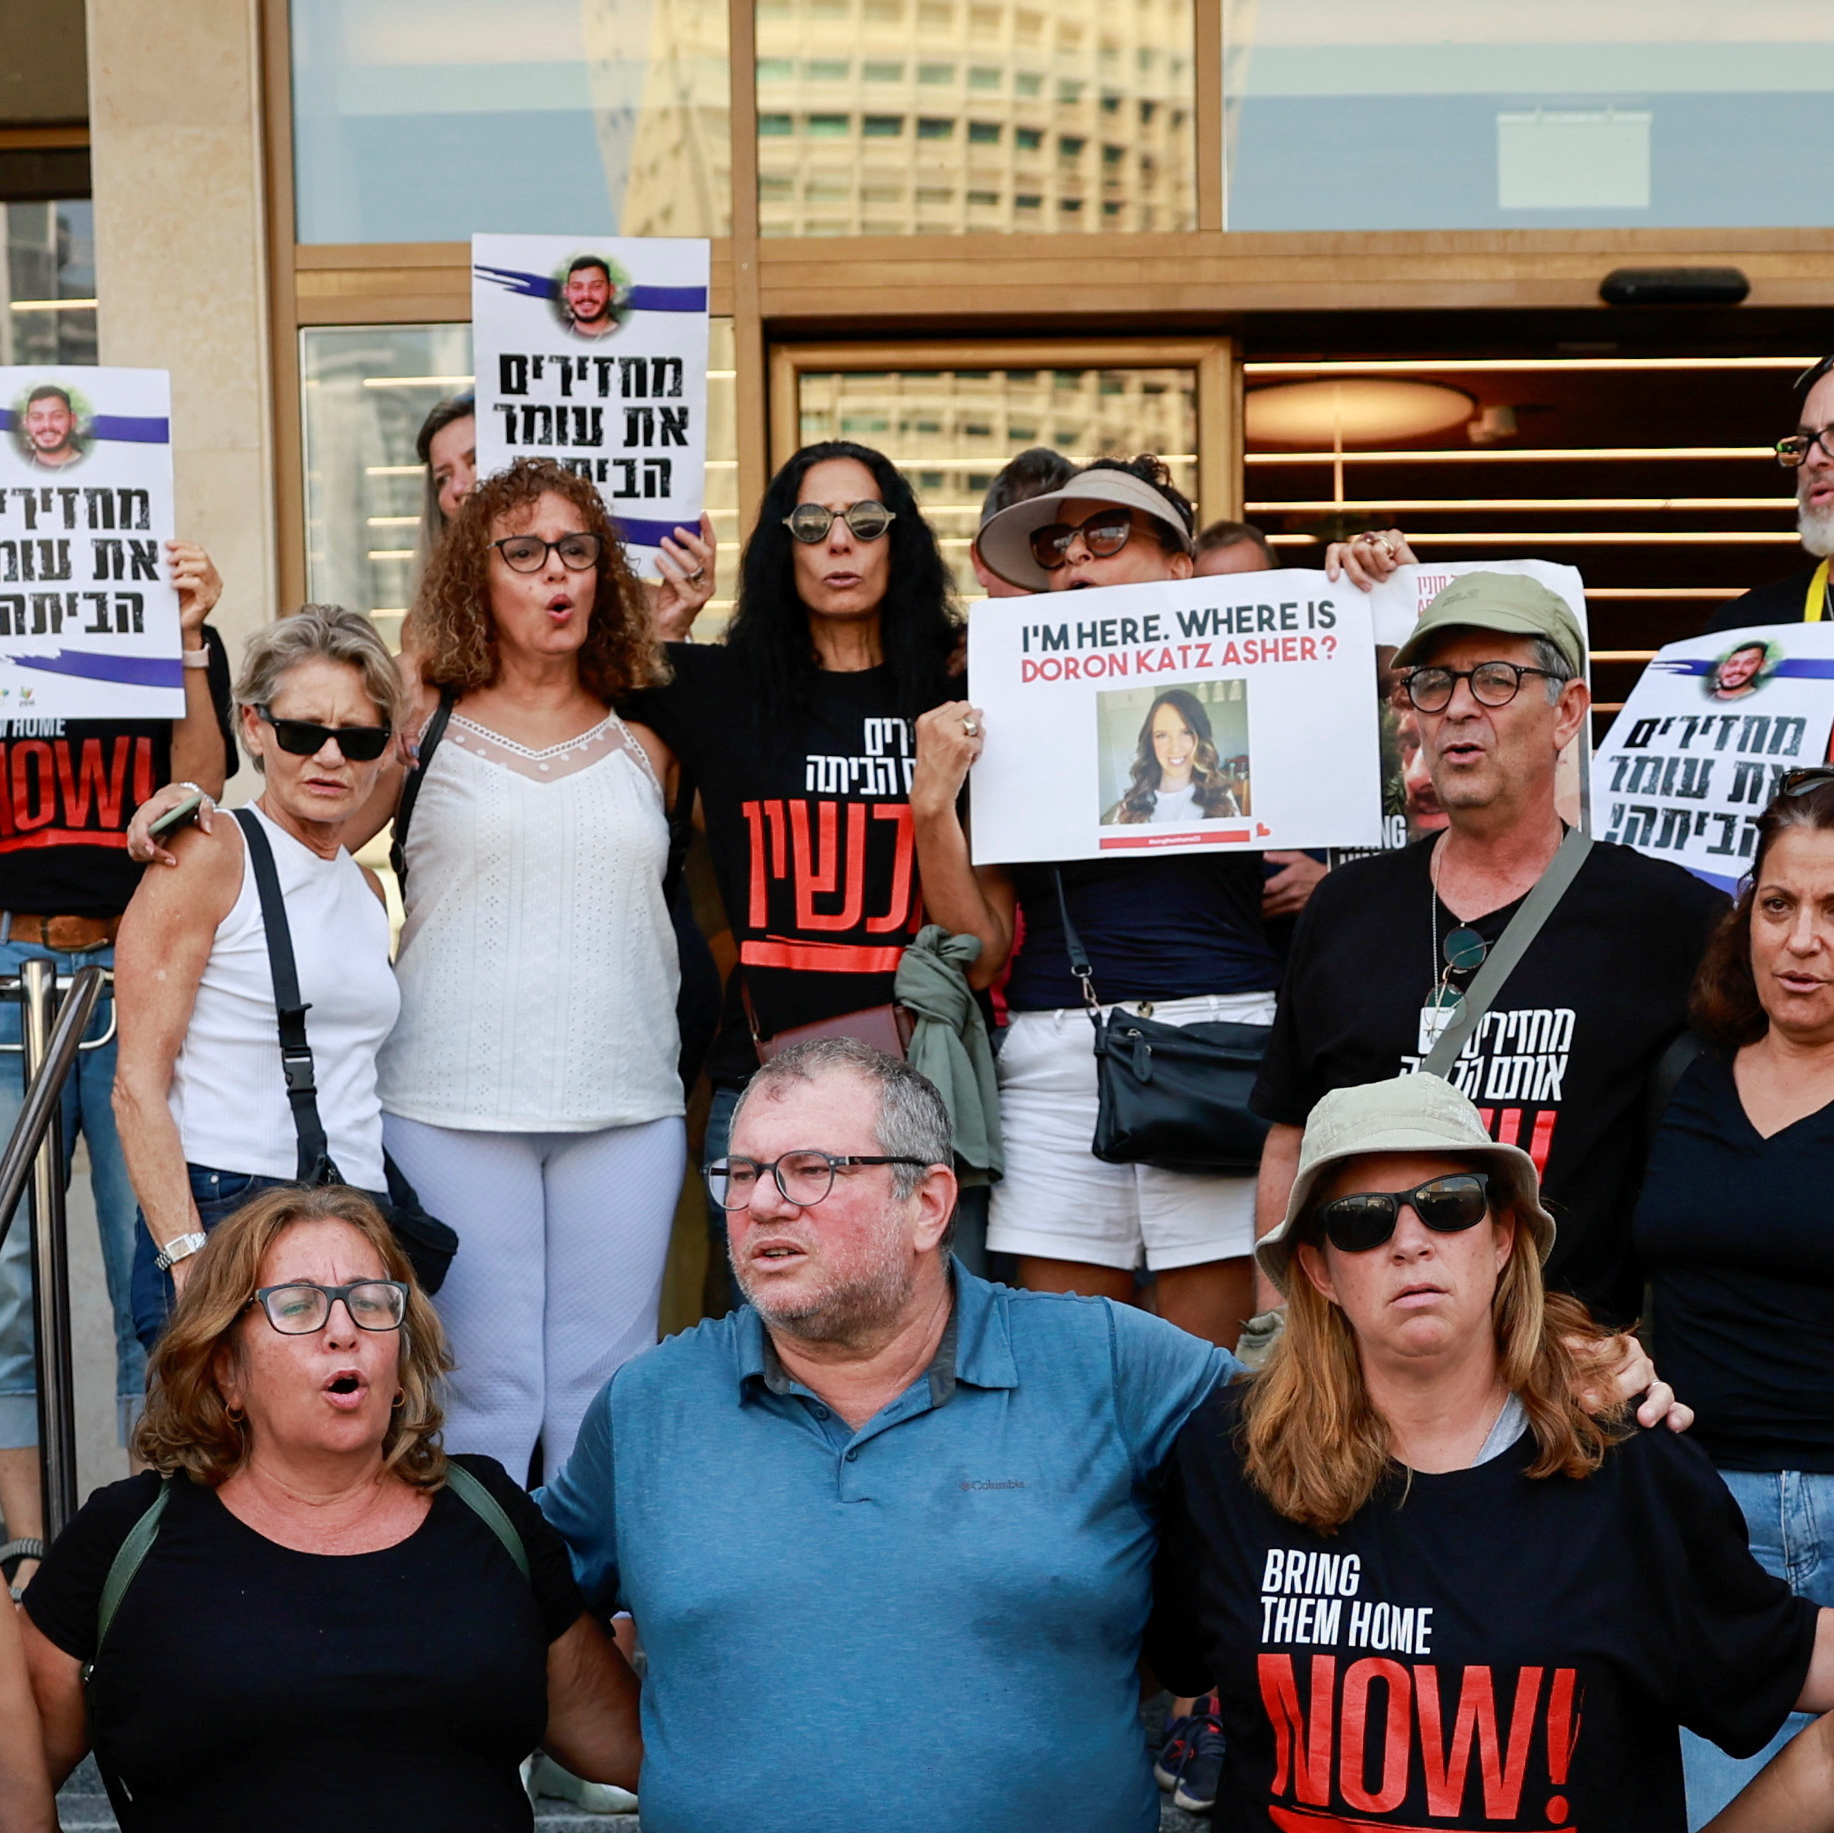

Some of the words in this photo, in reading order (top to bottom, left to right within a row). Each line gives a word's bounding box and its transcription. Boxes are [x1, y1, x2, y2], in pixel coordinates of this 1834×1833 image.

[499, 353, 683, 398] מחזירים
[493, 403, 603, 447] עומר
[623, 406, 689, 447] את
[91, 538, 160, 581] את
[1022, 623, 1068, 653] I'M
[1076, 614, 1170, 649] HERE.
[1176, 601, 1299, 638] WHERE
[1307, 600, 1337, 630] IS
[1021, 655, 1129, 683] DORON
[1135, 642, 1214, 674] KATZ
[1221, 635, 1338, 667] ASHER?
[1623, 714, 1807, 756] מחזירים
[805, 755, 898, 795] הביתה
[1609, 755, 1715, 799] עומר
[742, 799, 923, 933] כשיו
[1484, 1054, 1569, 1101] אותם
[1261, 1549, 1361, 1597] BRING
[1260, 1596, 1342, 1645] THEM
[1348, 1601, 1433, 1655] HOME
[1257, 1653, 1579, 1825] NOW!
